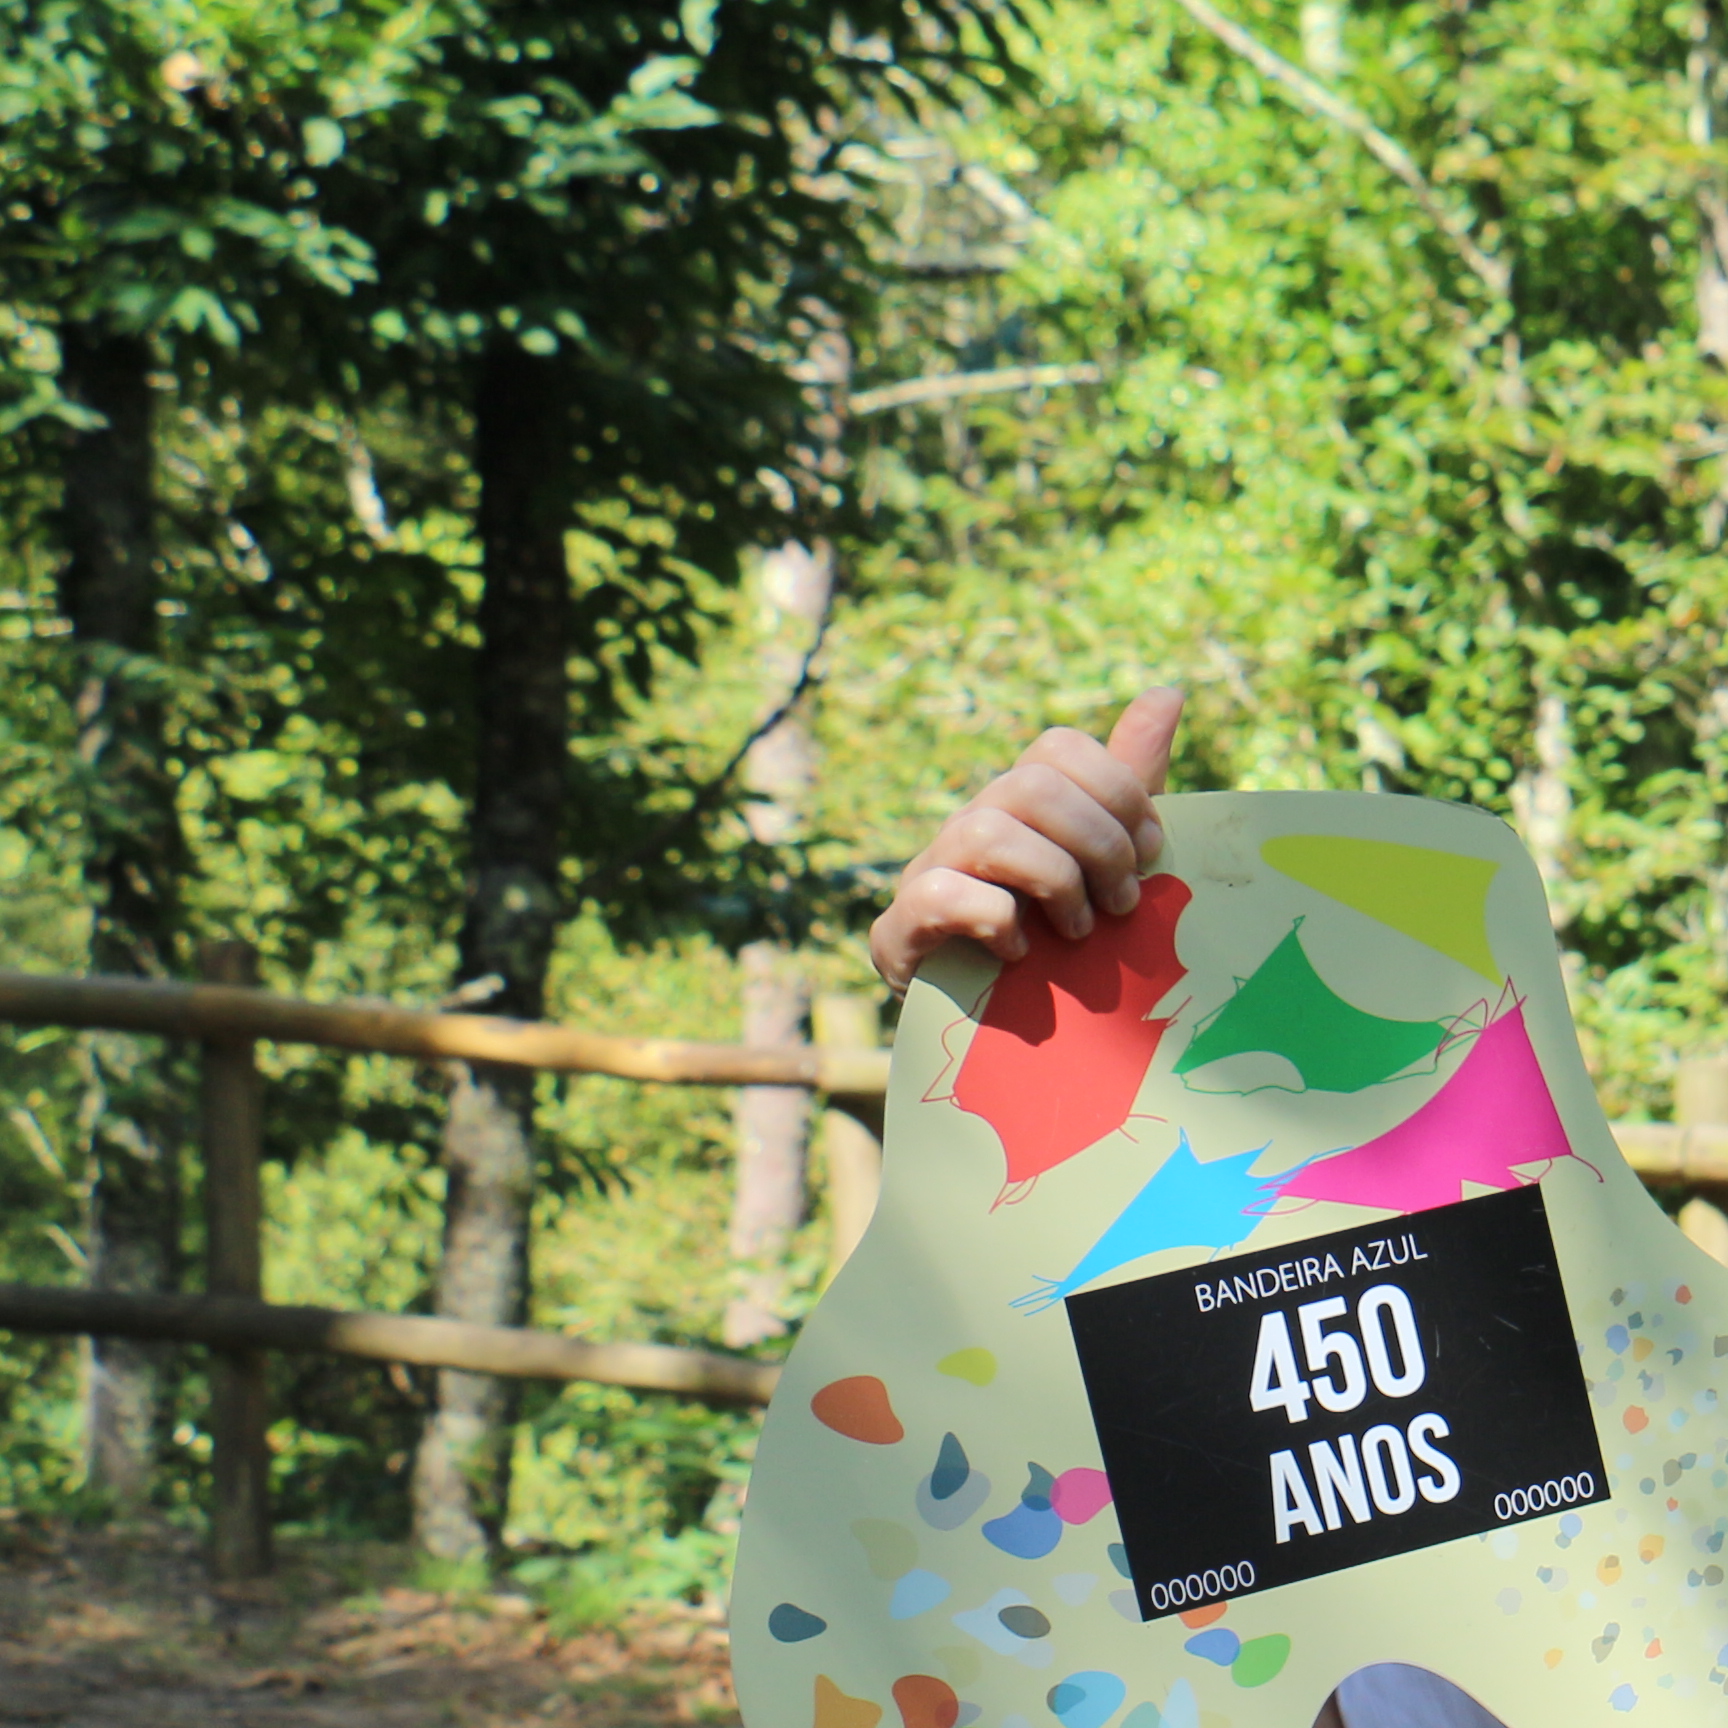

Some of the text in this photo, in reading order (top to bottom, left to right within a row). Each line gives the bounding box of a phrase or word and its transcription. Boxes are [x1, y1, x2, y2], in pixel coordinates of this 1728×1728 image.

[1194, 1233, 1429, 1313] BANDEIRA AZUL
[1248, 1283, 1426, 1424] 450
[1269, 1412, 1461, 1545] ANOS
